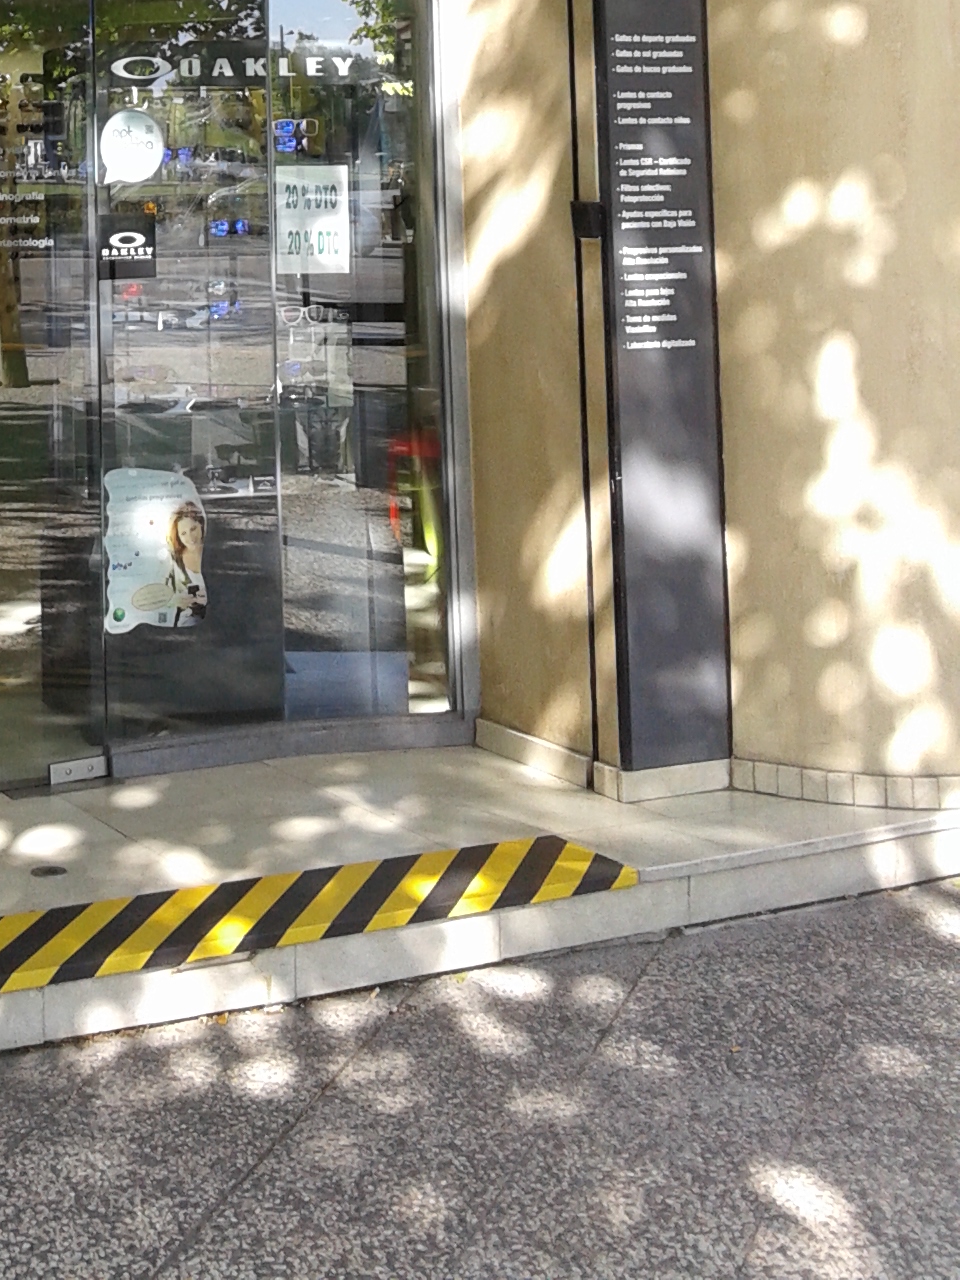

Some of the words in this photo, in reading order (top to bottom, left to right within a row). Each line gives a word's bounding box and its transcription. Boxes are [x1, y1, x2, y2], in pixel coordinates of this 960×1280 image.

[179, 56, 354, 78] OAKLEY
[285, 184, 298, 209] 20
[314, 184, 337, 209] DTO
[287, 230, 301, 255] 20
